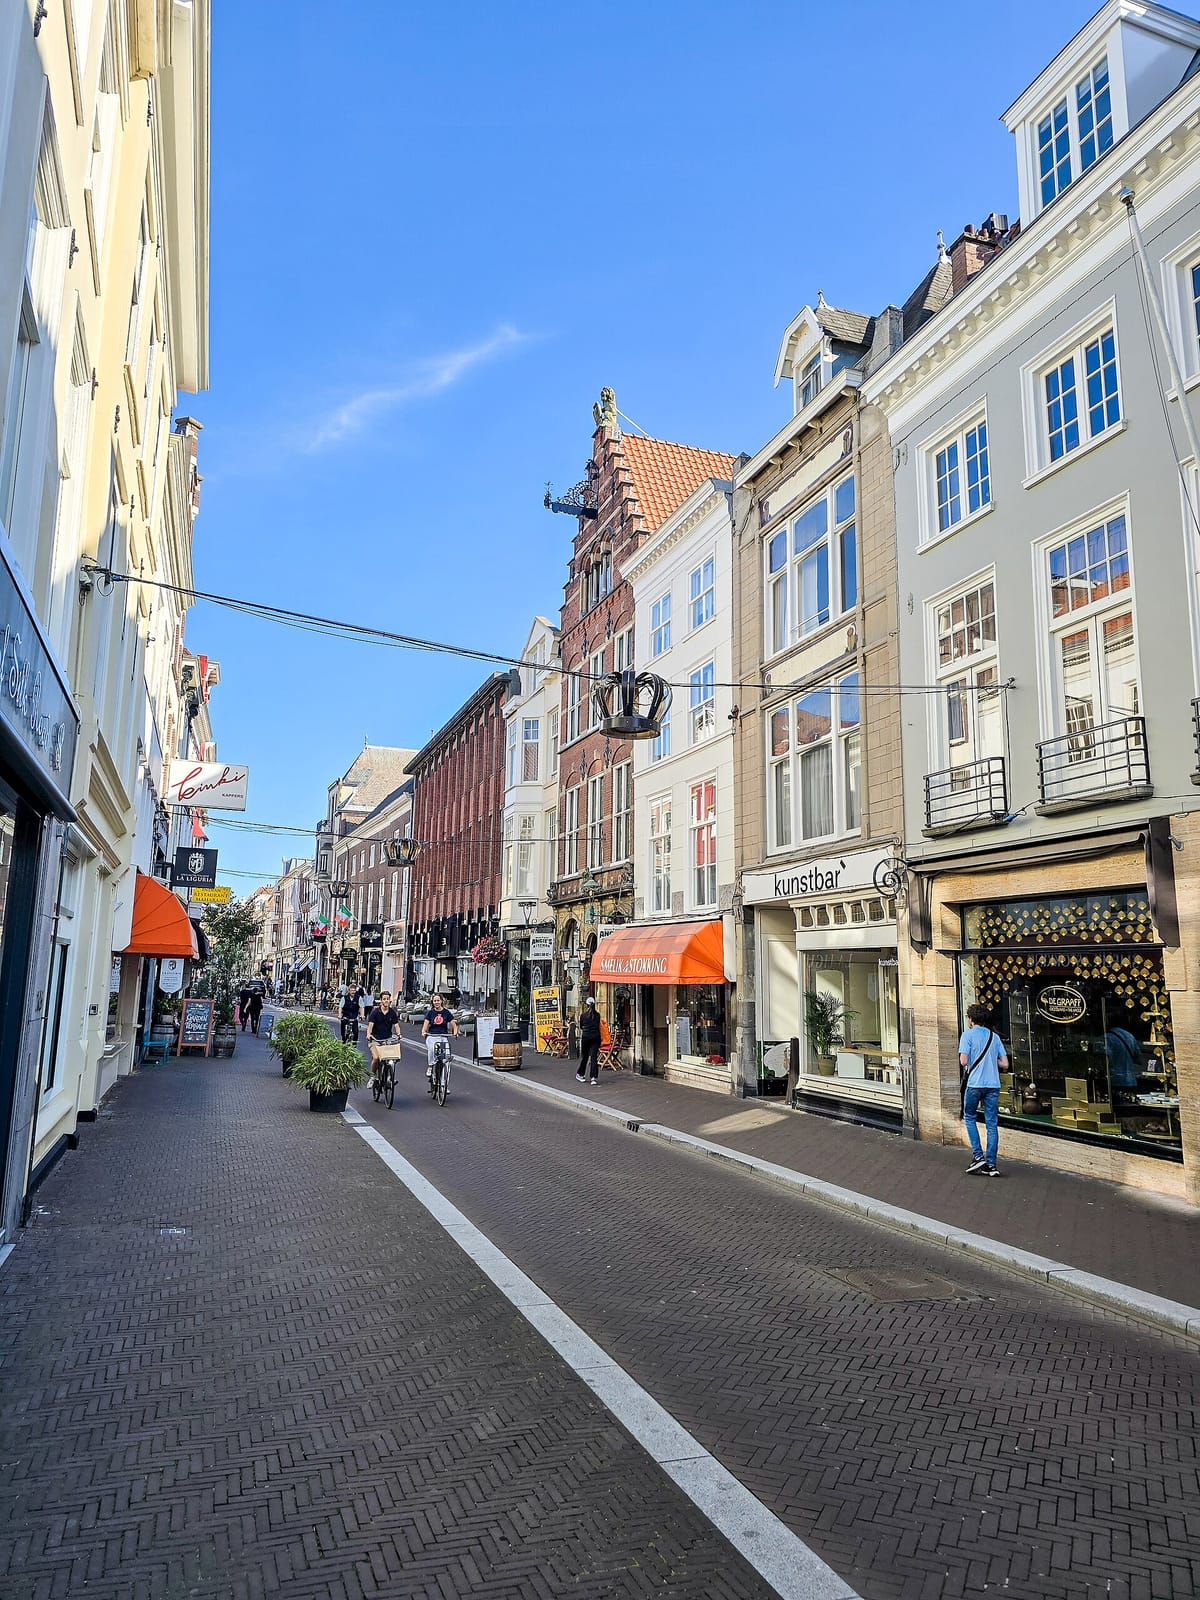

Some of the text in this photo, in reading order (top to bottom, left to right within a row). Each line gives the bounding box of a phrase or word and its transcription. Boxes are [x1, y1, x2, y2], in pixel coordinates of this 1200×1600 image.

[531, 938, 553, 946] ANGIE'S
[600, 958, 623, 973] SMELIK
[629, 957, 668, 974] STOKKING
